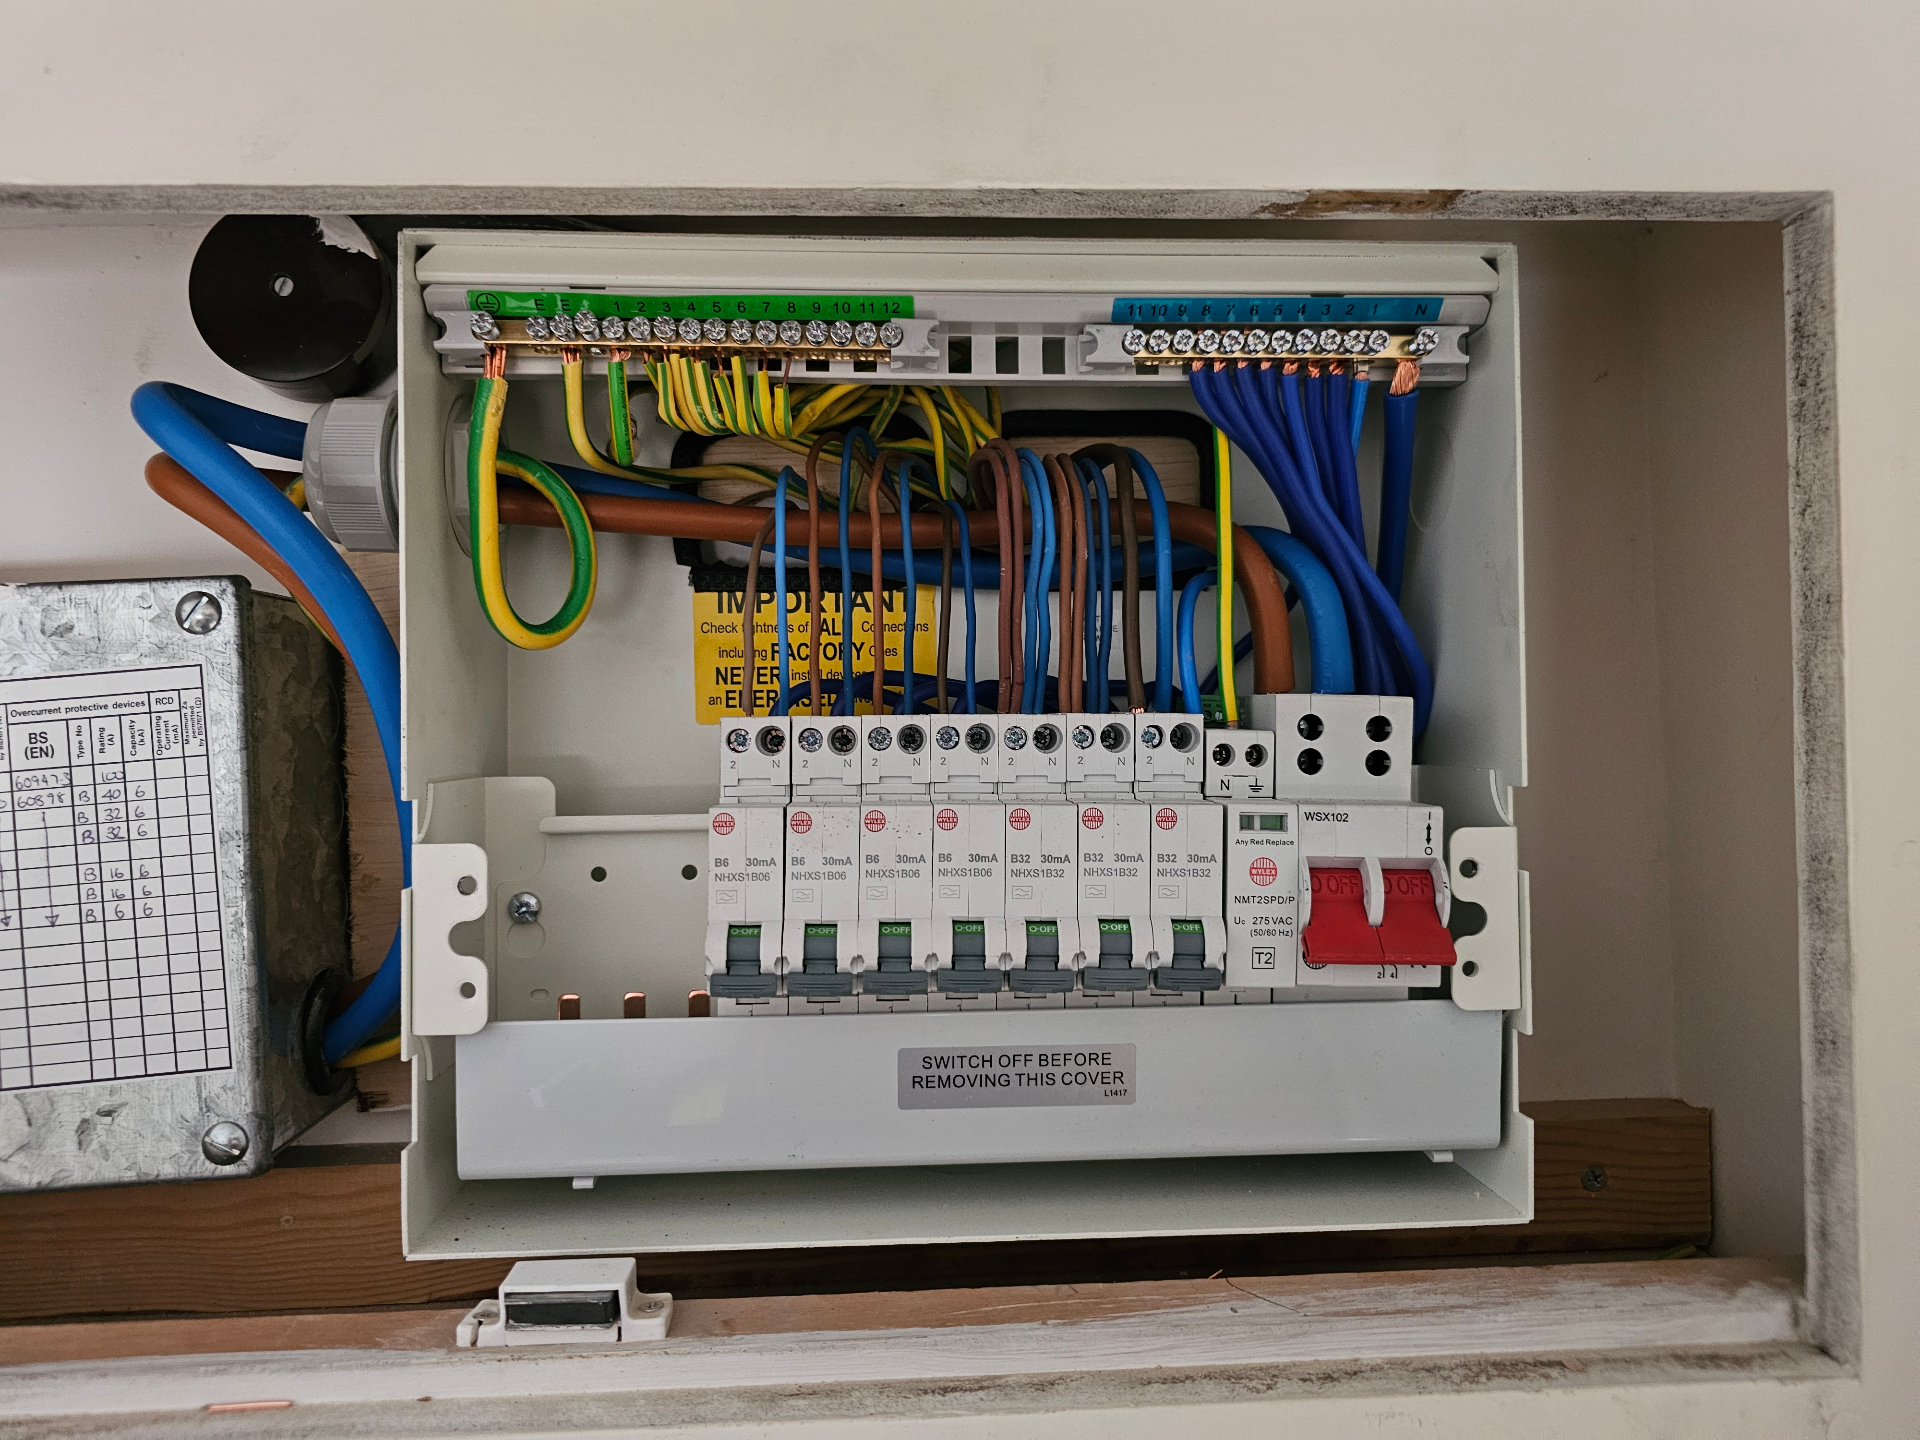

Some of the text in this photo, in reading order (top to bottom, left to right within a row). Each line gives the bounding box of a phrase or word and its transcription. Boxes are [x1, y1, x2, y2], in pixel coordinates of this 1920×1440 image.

[534, 298, 900, 313] E E 1 2 3 4 5 6 7 8 9 10 11 12
[1127, 304, 1428, 316] 11 10 9 8 7 6 5 4 3 2 1 N
[701, 621, 738, 633] Check
[742, 621, 794, 636] htnes
[798, 621, 809, 633] of
[718, 647, 768, 660] inclung
[868, 645, 898, 656] Oes
[716, 666, 781, 685] NEER
[155, 697, 174, 706] RCD
[708, 696, 722, 705] an
[10, 706, 62, 718] Overcurrent
[65, 702, 109, 714] protective
[112, 699, 146, 709] devices
[28, 732, 48, 744] BS
[138, 728, 146, 746] (kA)
[172, 724, 180, 744] (mA)
[76, 725, 86, 760] Type No
[24, 744, 55, 760] (EN)
[730, 760, 780, 769] 2 N
[802, 759, 852, 768] 2 N
[872, 758, 921, 766] 2 N
[940, 757, 988, 765] 2 N
[1049, 757, 1056, 766] N
[1078, 756, 1125, 765] 2 N
[1146, 756, 1194, 765] 2 N
[1220, 779, 1230, 790] N
[102, 788, 122, 800] 40
[135, 785, 146, 798] 6
[78, 806, 146, 823] B 32 6
[1304, 812, 1349, 822] WSX102
[106, 826, 126, 840] 32
[138, 824, 148, 837] 6
[791, 857, 852, 866] B6 30mA
[865, 855, 926, 864] B6 30mA
[938, 854, 998, 862] B6 30mA
[1011, 854, 1070, 863] B32 30mA
[1084, 853, 1144, 862] B32 30mA
[1157, 854, 1217, 863] B32 30mA
[715, 858, 777, 867] B6 30mA
[84, 864, 150, 881] B 16 6
[791, 872, 846, 880] NHXS1B06
[865, 869, 920, 878] NHXS1B06
[938, 868, 992, 877] NHXS1B06
[1011, 869, 1064, 878] NHXS1B32
[1084, 868, 1138, 877] NHXS1B32
[1157, 869, 1211, 878] NHXS1B32
[715, 873, 770, 882] NHXS1B06
[1327, 875, 1358, 895] OFF
[1397, 876, 1429, 895] OFF
[86, 885, 152, 900] B 16 6
[1234, 896, 1295, 904] NMT2SPD/P
[86, 902, 154, 923] B 6 6
[1252, 916, 1270, 925] 275
[1272, 916, 1293, 925] VAC
[1250, 928, 1293, 938] (50/60 Hz)
[1254, 952, 1273, 964] T2
[922, 1052, 1112, 1070] SWITCH OFF BEFORE
[912, 1071, 1125, 1089] REMOVING THIS COVER
[1104, 1089, 1128, 1098] L1417
